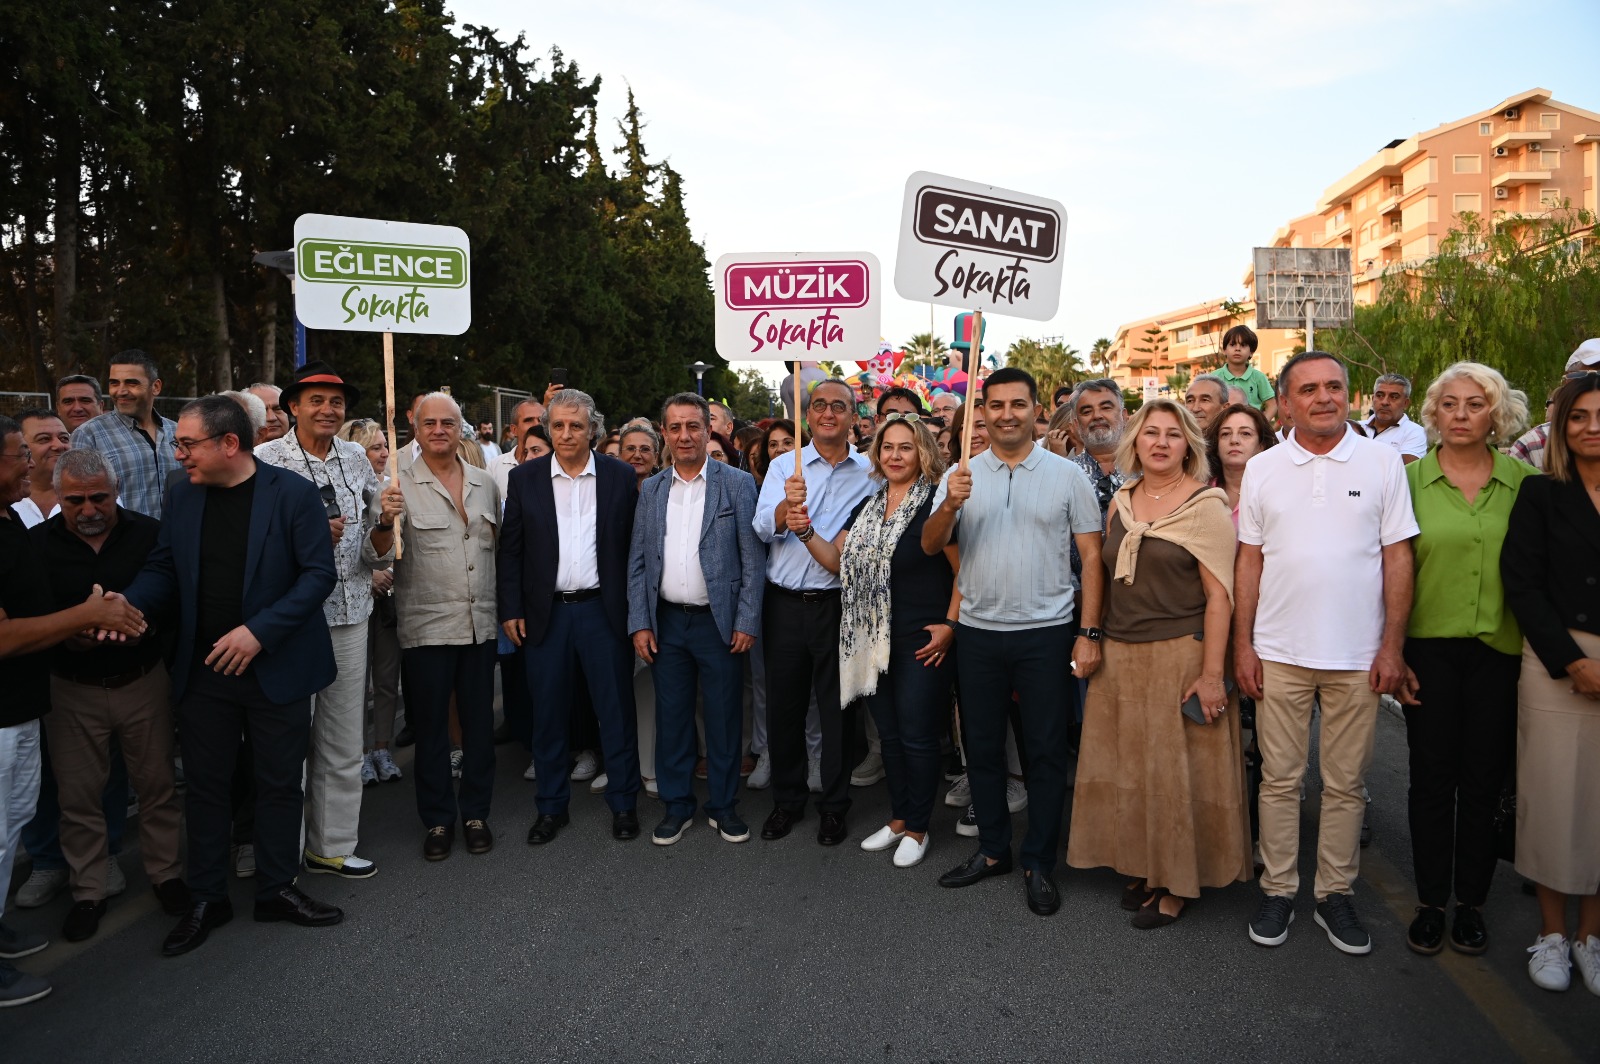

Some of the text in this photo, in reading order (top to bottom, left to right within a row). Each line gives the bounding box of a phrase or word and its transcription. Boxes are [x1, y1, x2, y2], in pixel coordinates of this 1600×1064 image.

[933, 203, 1046, 248] SANAT
[314, 245, 453, 280] EĞLENCE
[744, 266, 851, 300] MÜZİK
[933, 249, 1031, 305] Sokakta
[341, 285, 429, 324] Sokakta
[749, 307, 844, 353] Sokakta
